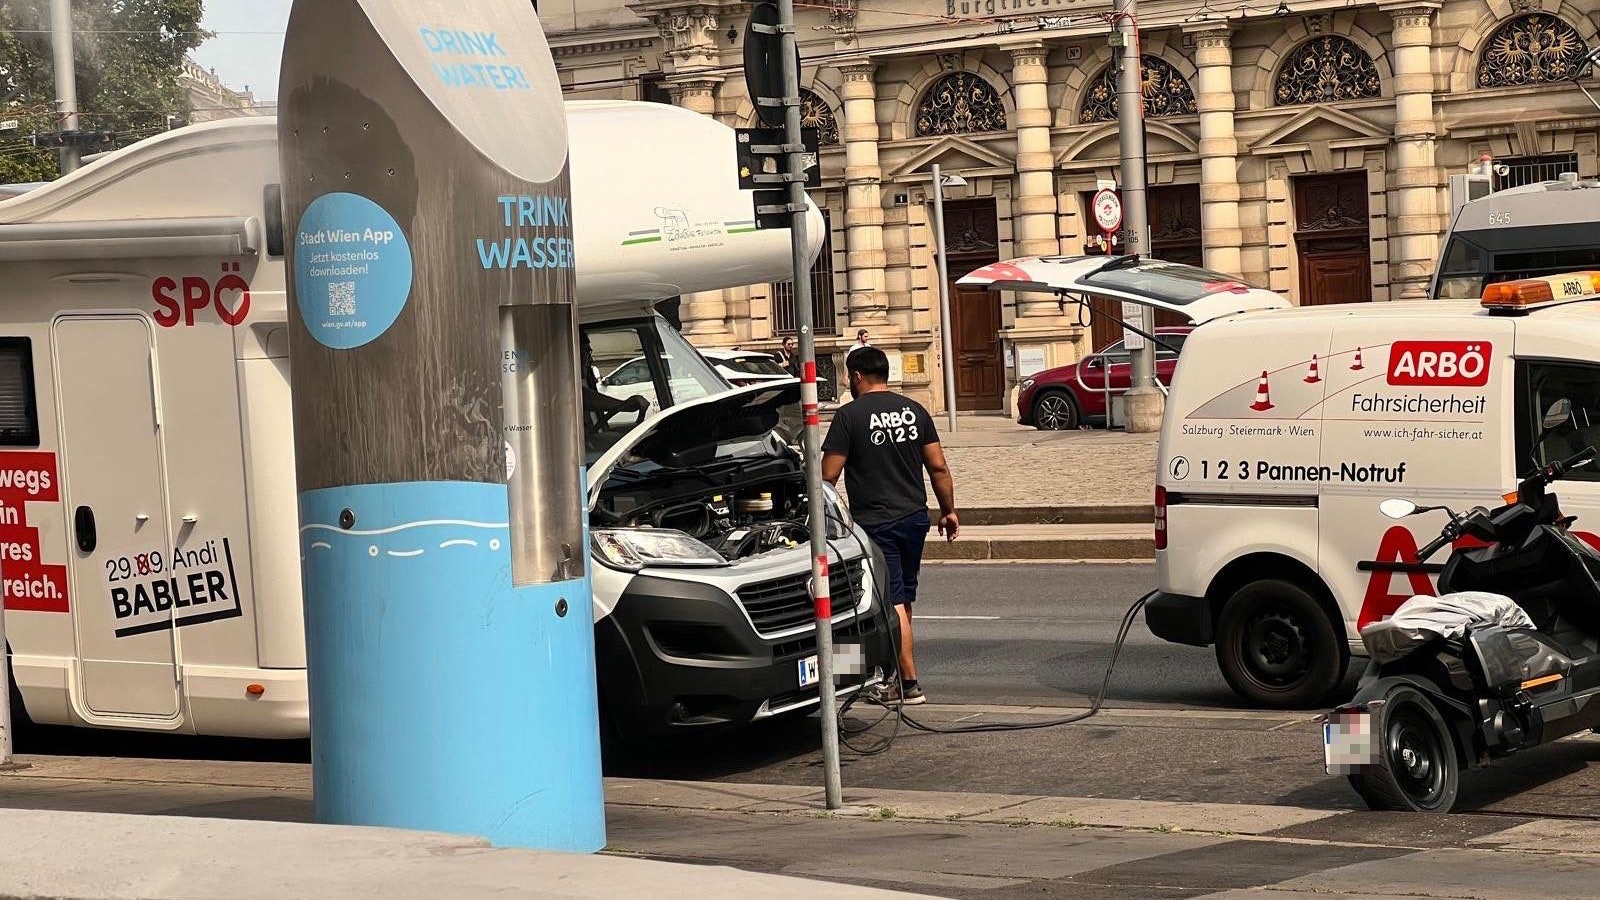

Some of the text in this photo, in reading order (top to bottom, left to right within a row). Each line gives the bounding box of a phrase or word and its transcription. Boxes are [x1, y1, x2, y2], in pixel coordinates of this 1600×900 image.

[419, 26, 506, 56] DRINK
[431, 61, 530, 90] WATER!
[497, 196, 569, 226] TRINK
[1488, 212, 1512, 225] 645
[300, 228, 394, 245] Stadt Wien App
[309, 250, 379, 263] Jetzt kostenlos
[476, 238, 575, 268] WASSER
[309, 264, 369, 276] downloaden!
[151, 262, 251, 328] SPÖ
[1562, 279, 1582, 296] ARBÖ
[321, 320, 368, 329] wien.gv.at/app
[1394, 345, 1485, 379] ARBÖ
[1352, 392, 1487, 414] Fahrsicherheit
[871, 407, 917, 429] ARBÖ
[1182, 424, 1315, 438] Salzburg Steiermark Wien
[1363, 427, 1483, 441] www.ich-fahr-sicher.at
[1201, 460, 1406, 482] 1 2 3 Pannen-Notruf
[172, 539, 218, 570] Andi
[111, 569, 229, 619] BABLER
[808, 660, 816, 678] W
